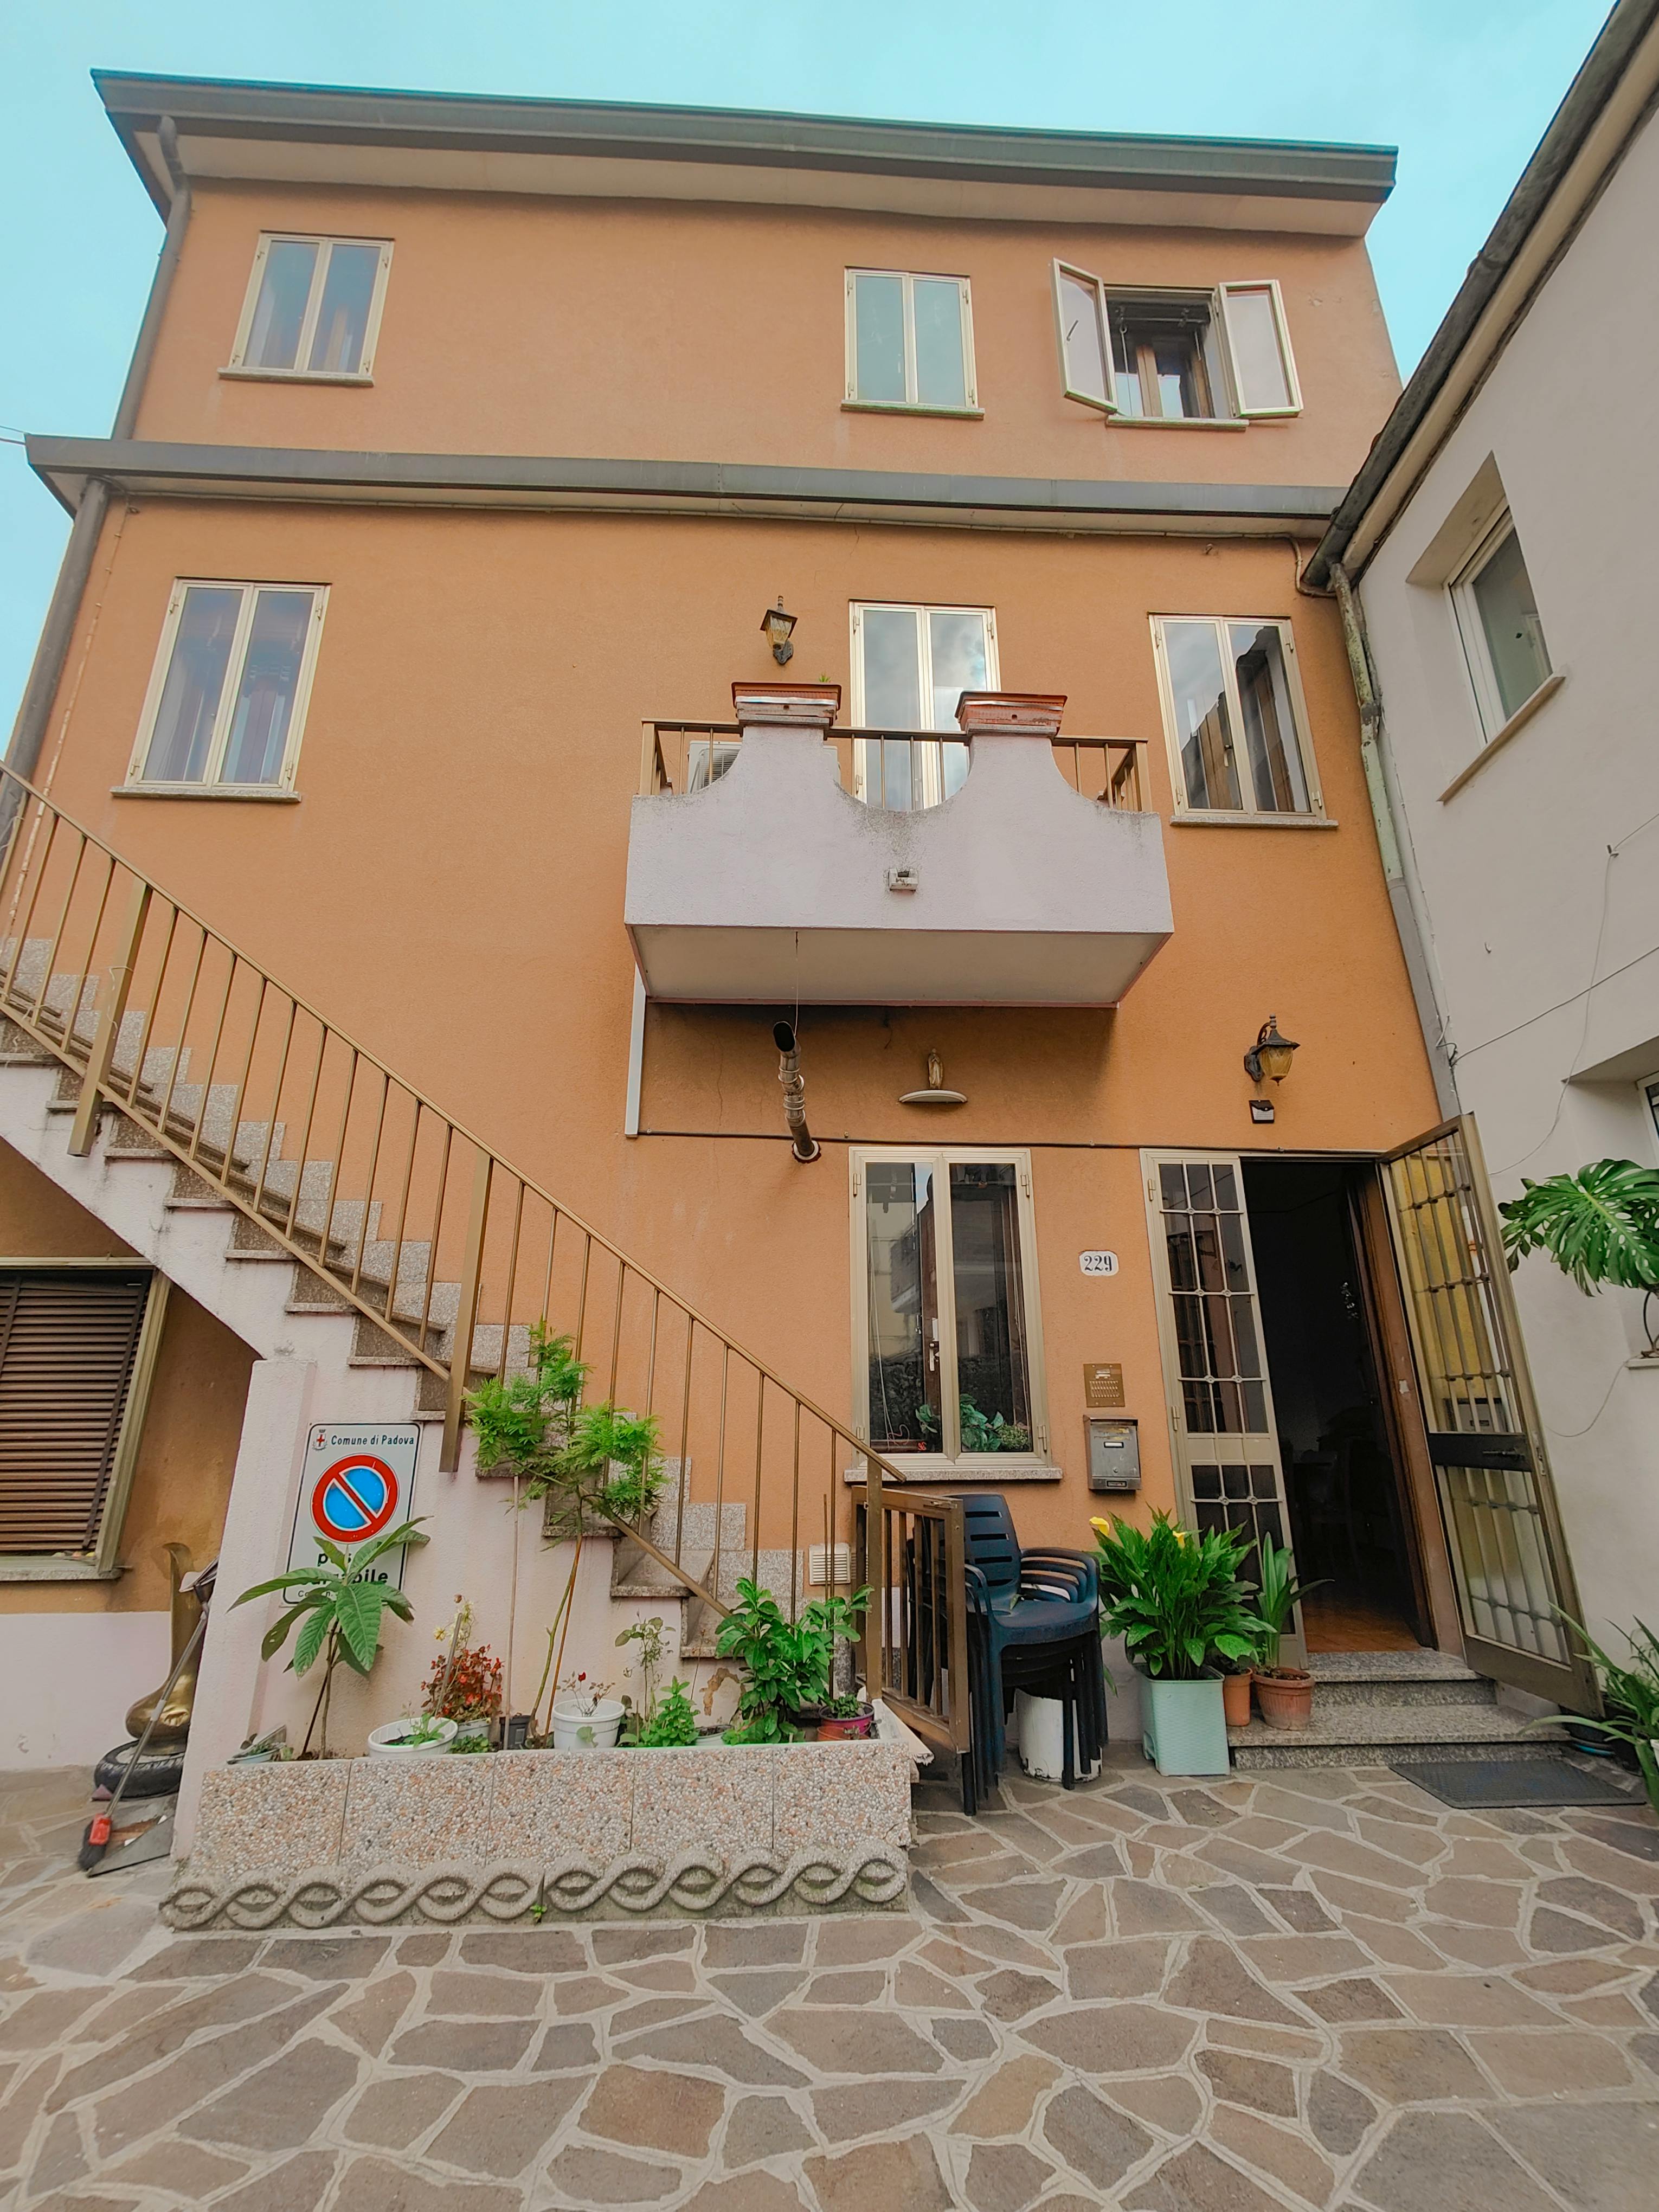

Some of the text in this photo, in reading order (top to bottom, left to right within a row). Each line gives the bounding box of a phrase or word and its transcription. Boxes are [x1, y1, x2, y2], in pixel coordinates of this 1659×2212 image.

[1083, 1255, 1112, 1272] 229
[331, 1435, 414, 1445] Comune di Padova
